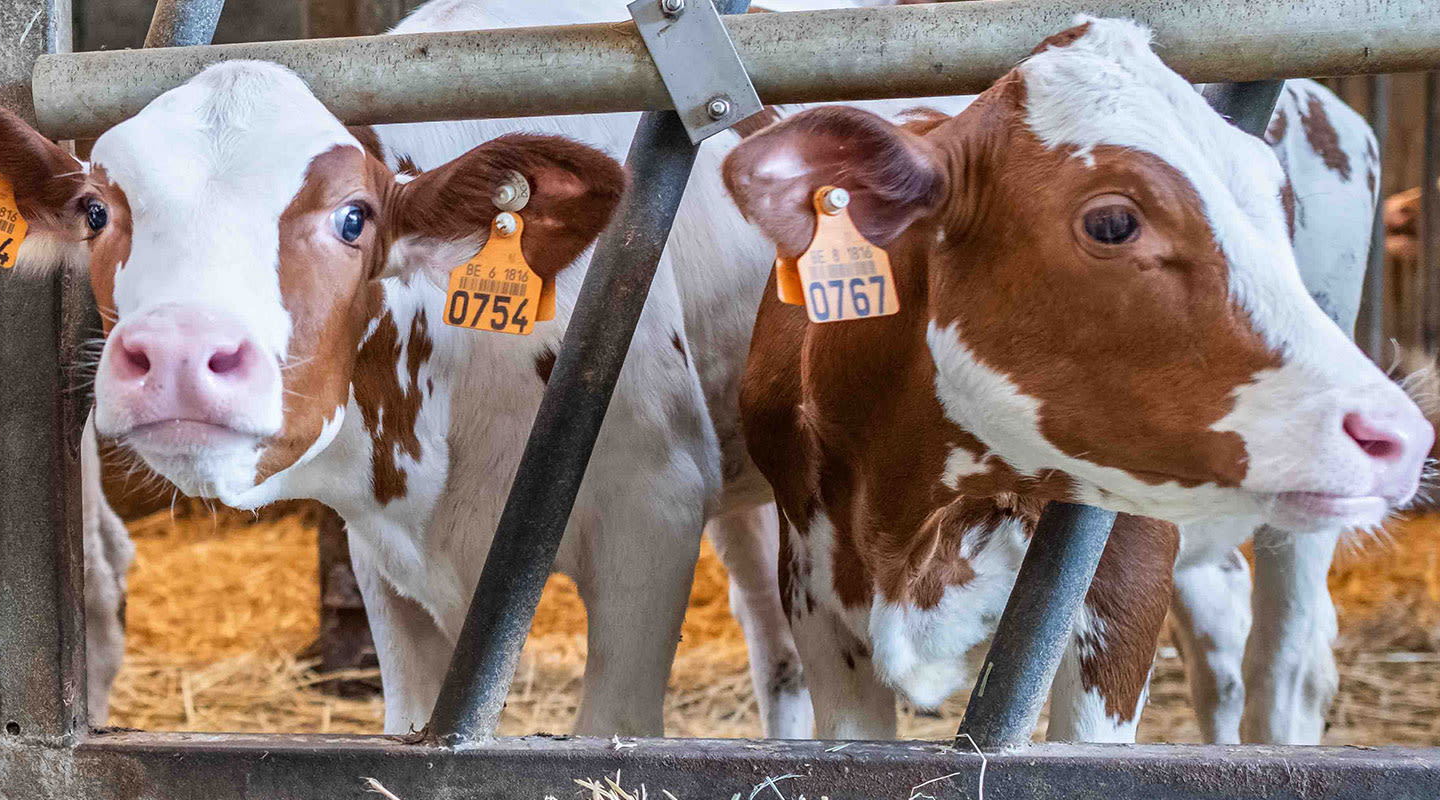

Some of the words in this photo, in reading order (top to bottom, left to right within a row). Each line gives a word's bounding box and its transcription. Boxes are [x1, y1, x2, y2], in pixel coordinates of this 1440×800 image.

[466, 263, 482, 277] BE
[488, 266, 496, 279] 6
[504, 268, 529, 282] 1816
[448, 290, 529, 333] 0754
[809, 275, 885, 321] 0767
